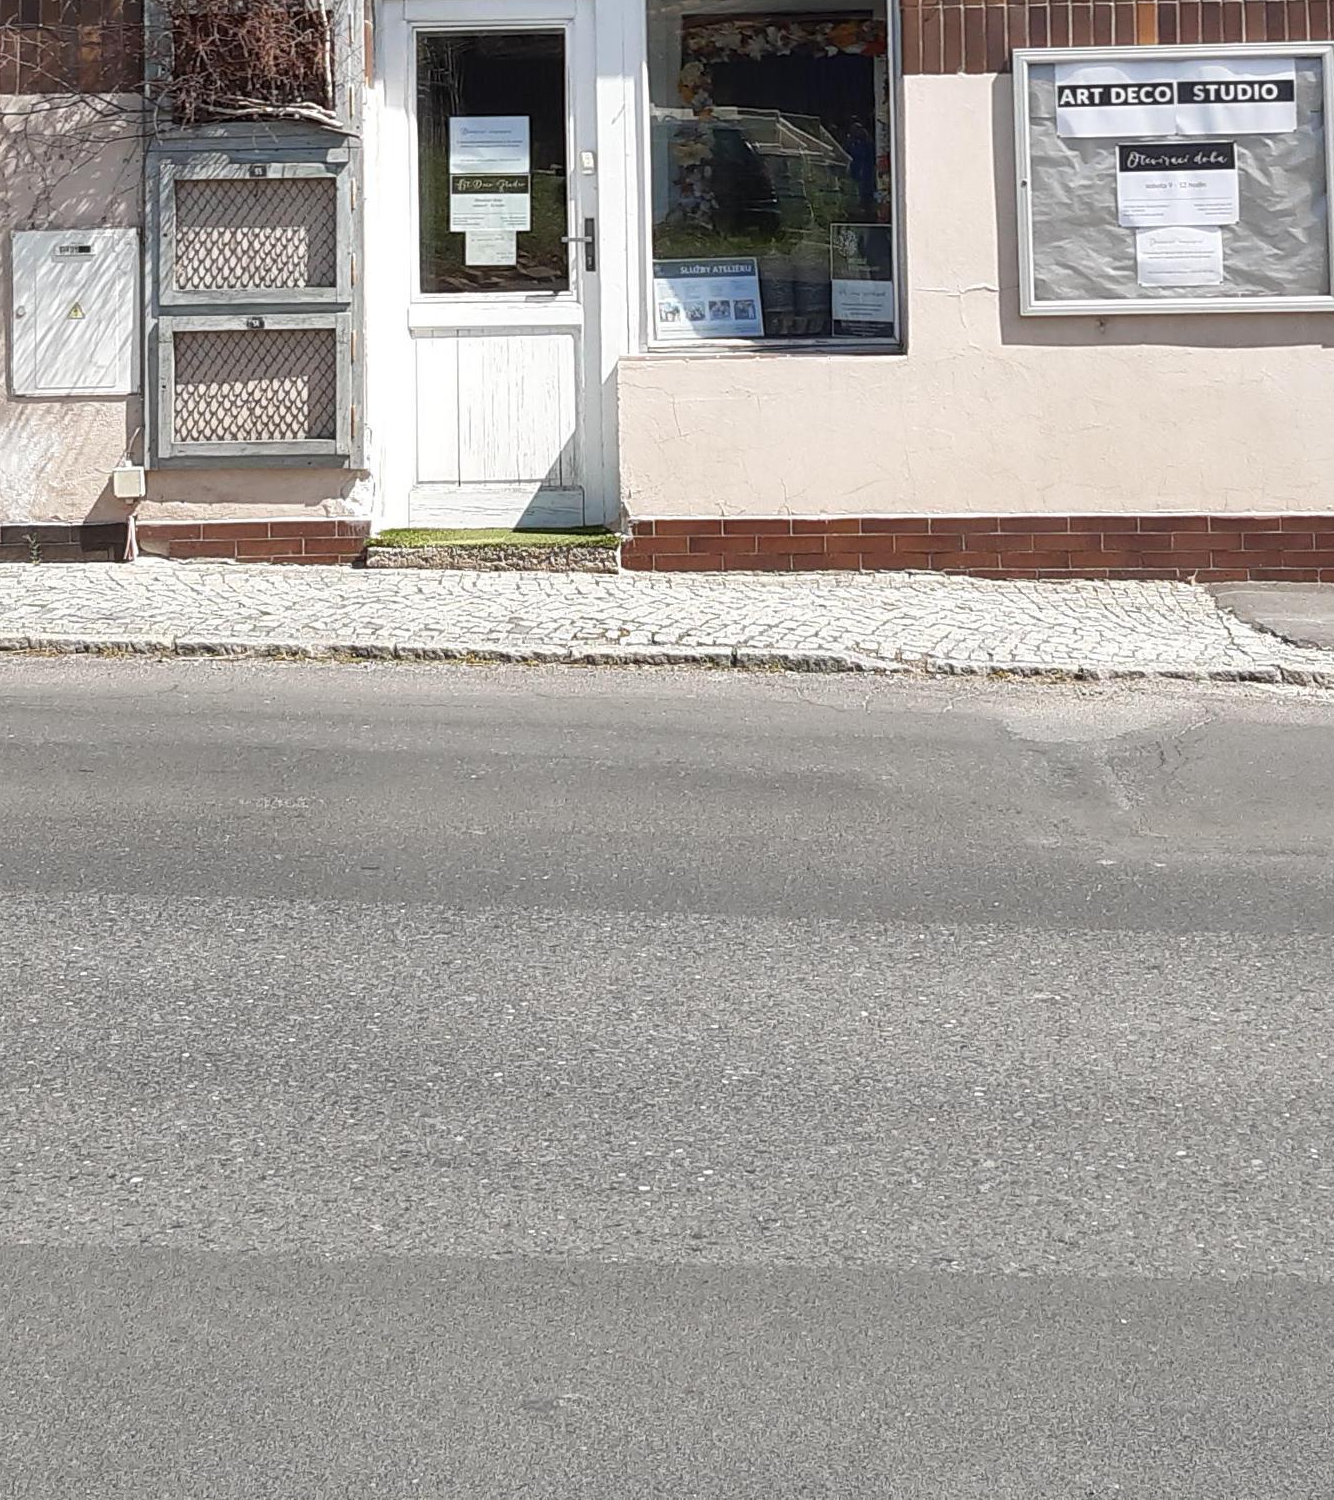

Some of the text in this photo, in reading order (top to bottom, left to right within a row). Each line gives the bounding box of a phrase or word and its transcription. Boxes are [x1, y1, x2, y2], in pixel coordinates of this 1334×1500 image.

[1059, 83, 1279, 105] ART DECO STUDIO
